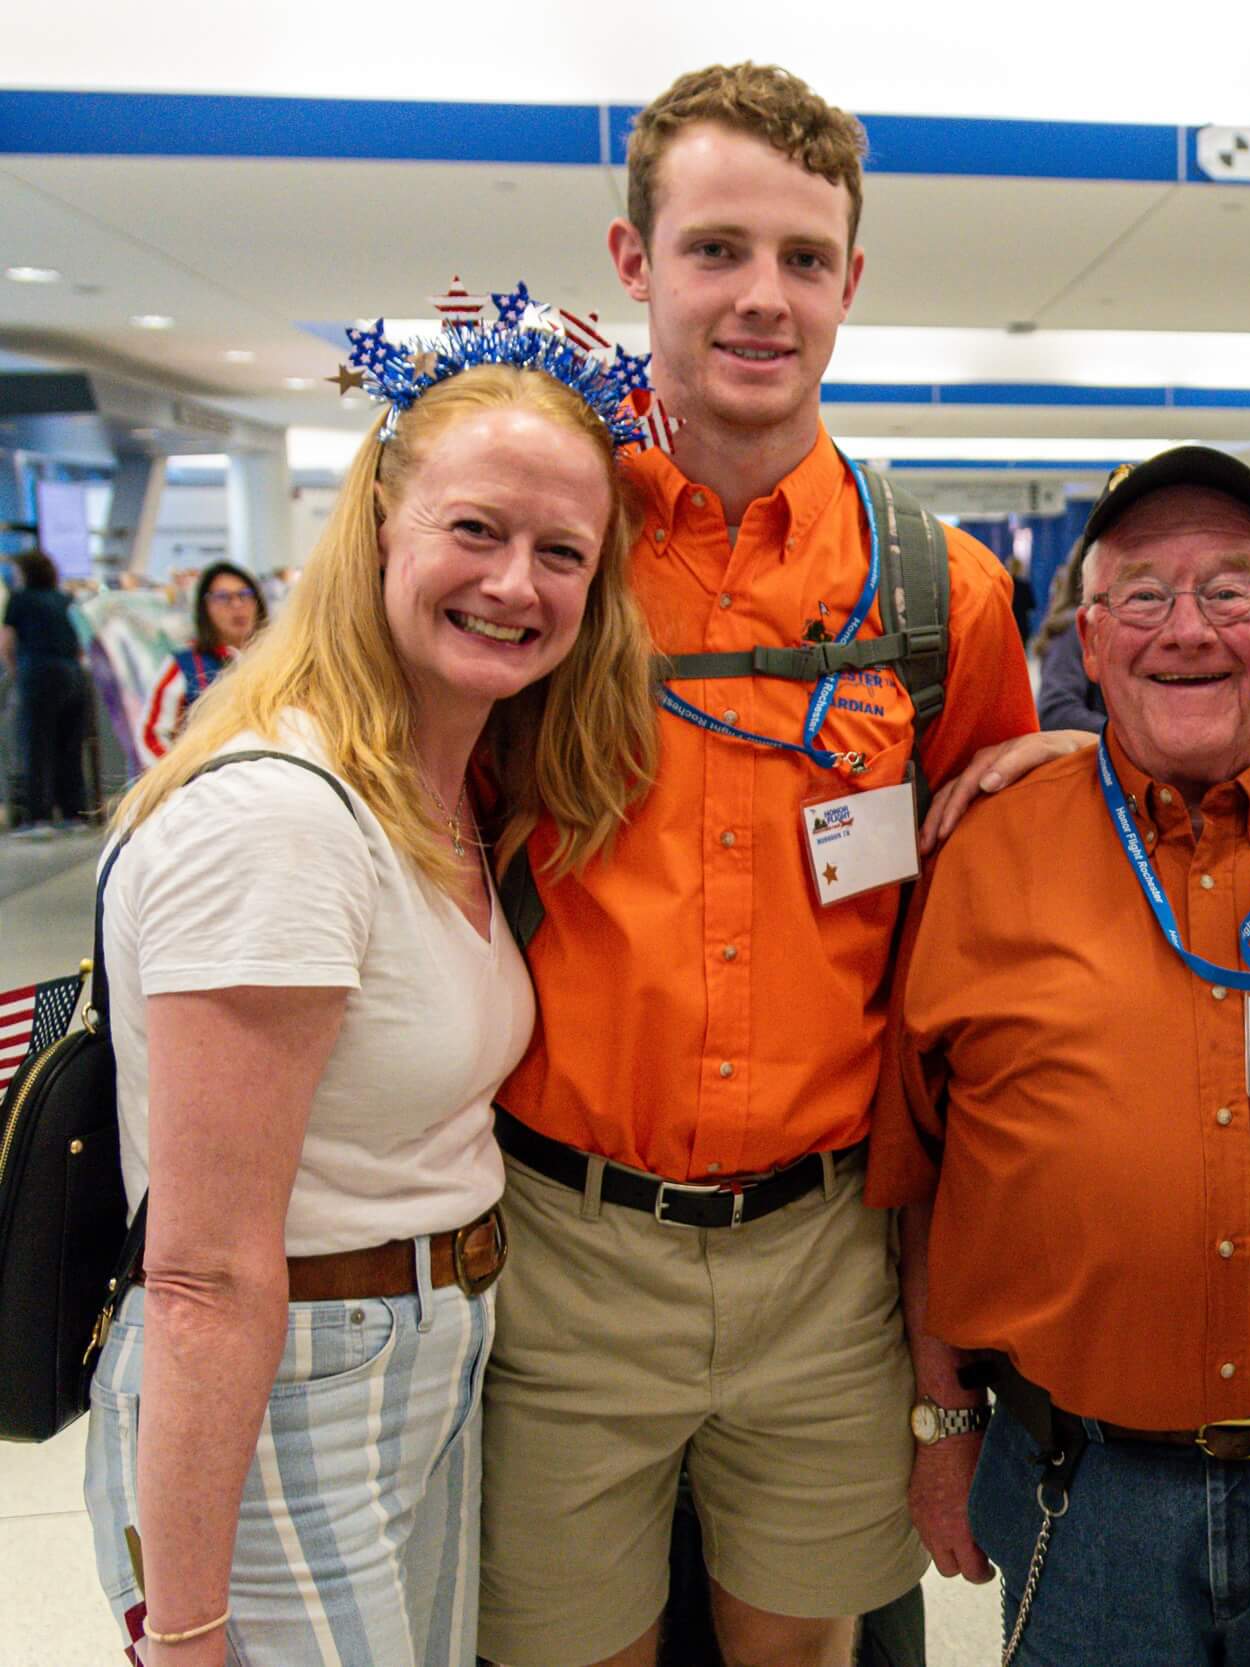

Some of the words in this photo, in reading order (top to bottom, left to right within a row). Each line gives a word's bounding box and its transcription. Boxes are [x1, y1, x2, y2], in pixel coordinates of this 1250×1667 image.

[841, 616, 861, 645] Hono
[840, 671, 882, 689] ESTER
[662, 695, 708, 728] Rochest
[808, 682, 835, 733] Rochester
[831, 696, 885, 718] RDIAN
[1115, 806, 1132, 833] Honor
[1126, 832, 1144, 860] Flight
[1137, 860, 1164, 904] Rochester
